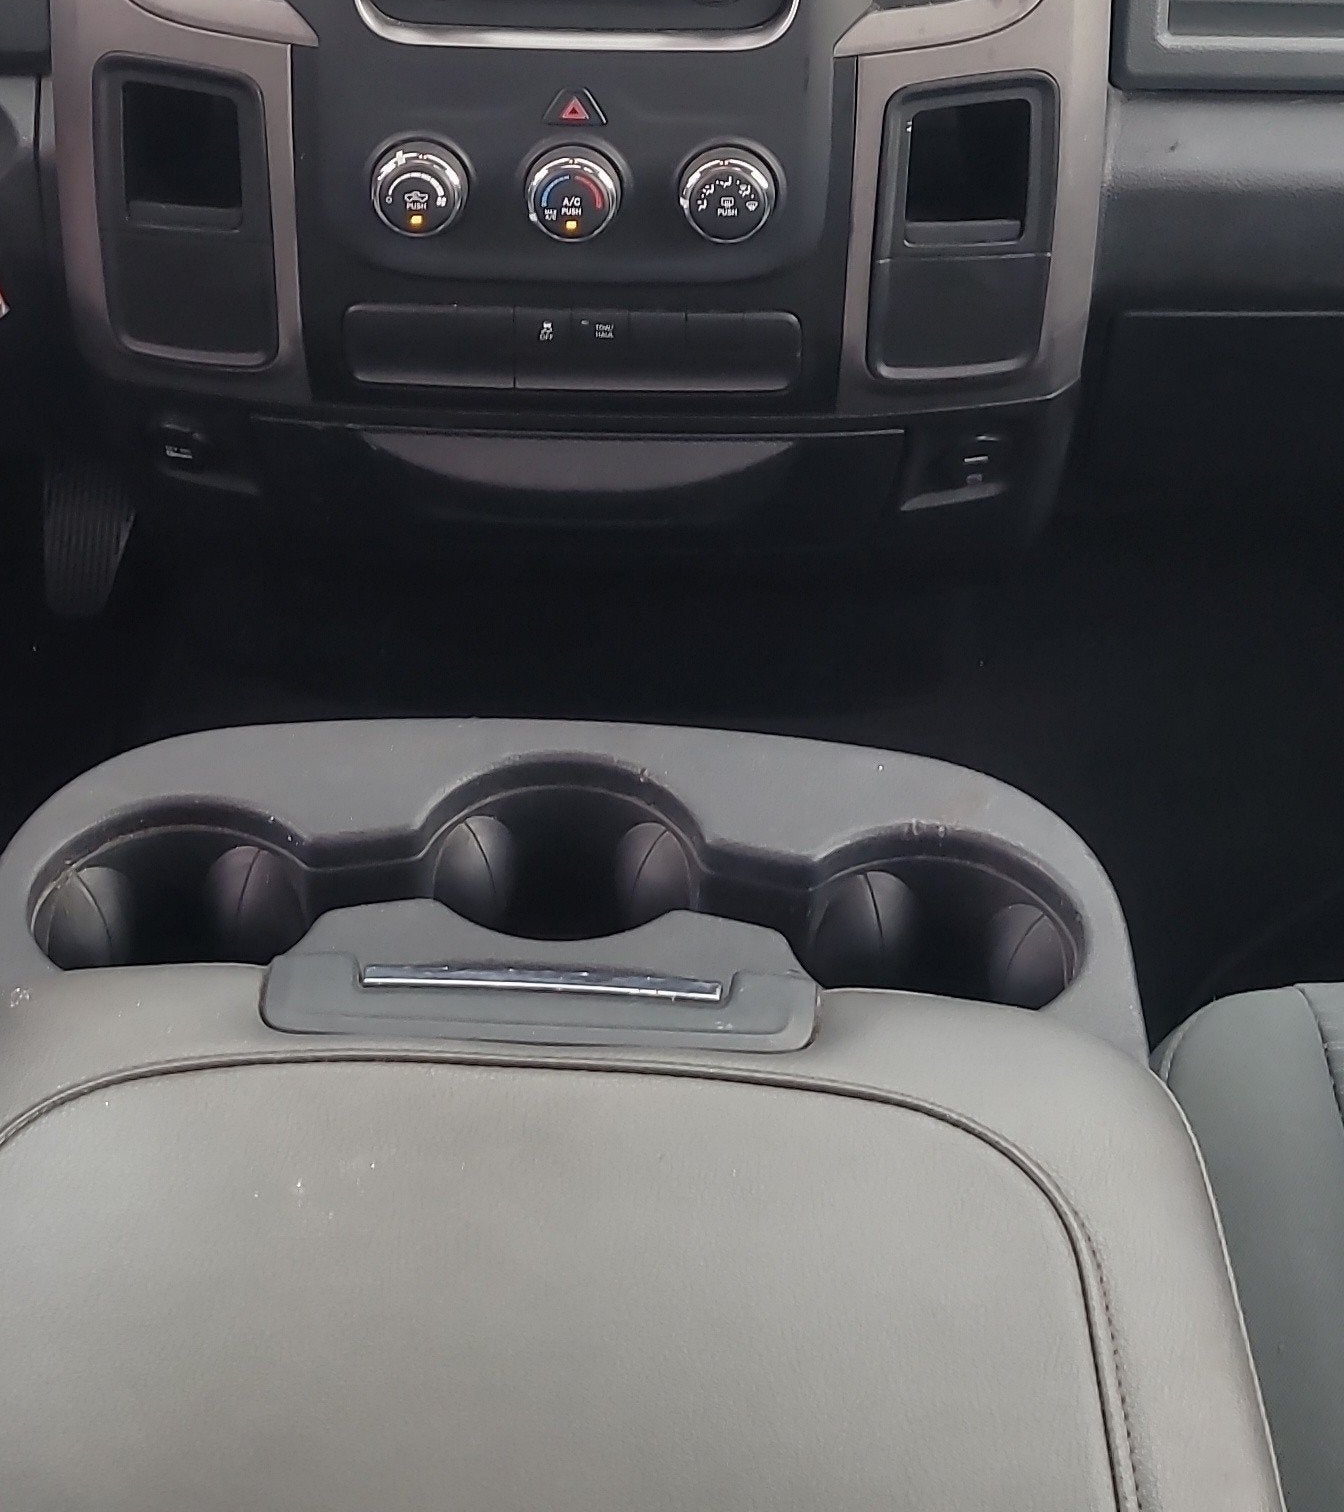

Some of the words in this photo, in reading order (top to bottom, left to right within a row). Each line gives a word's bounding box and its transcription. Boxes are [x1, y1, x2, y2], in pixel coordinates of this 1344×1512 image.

[562, 197, 581, 206] A/C
[561, 208, 582, 216] PUSH
[718, 208, 738, 216] PUSH
